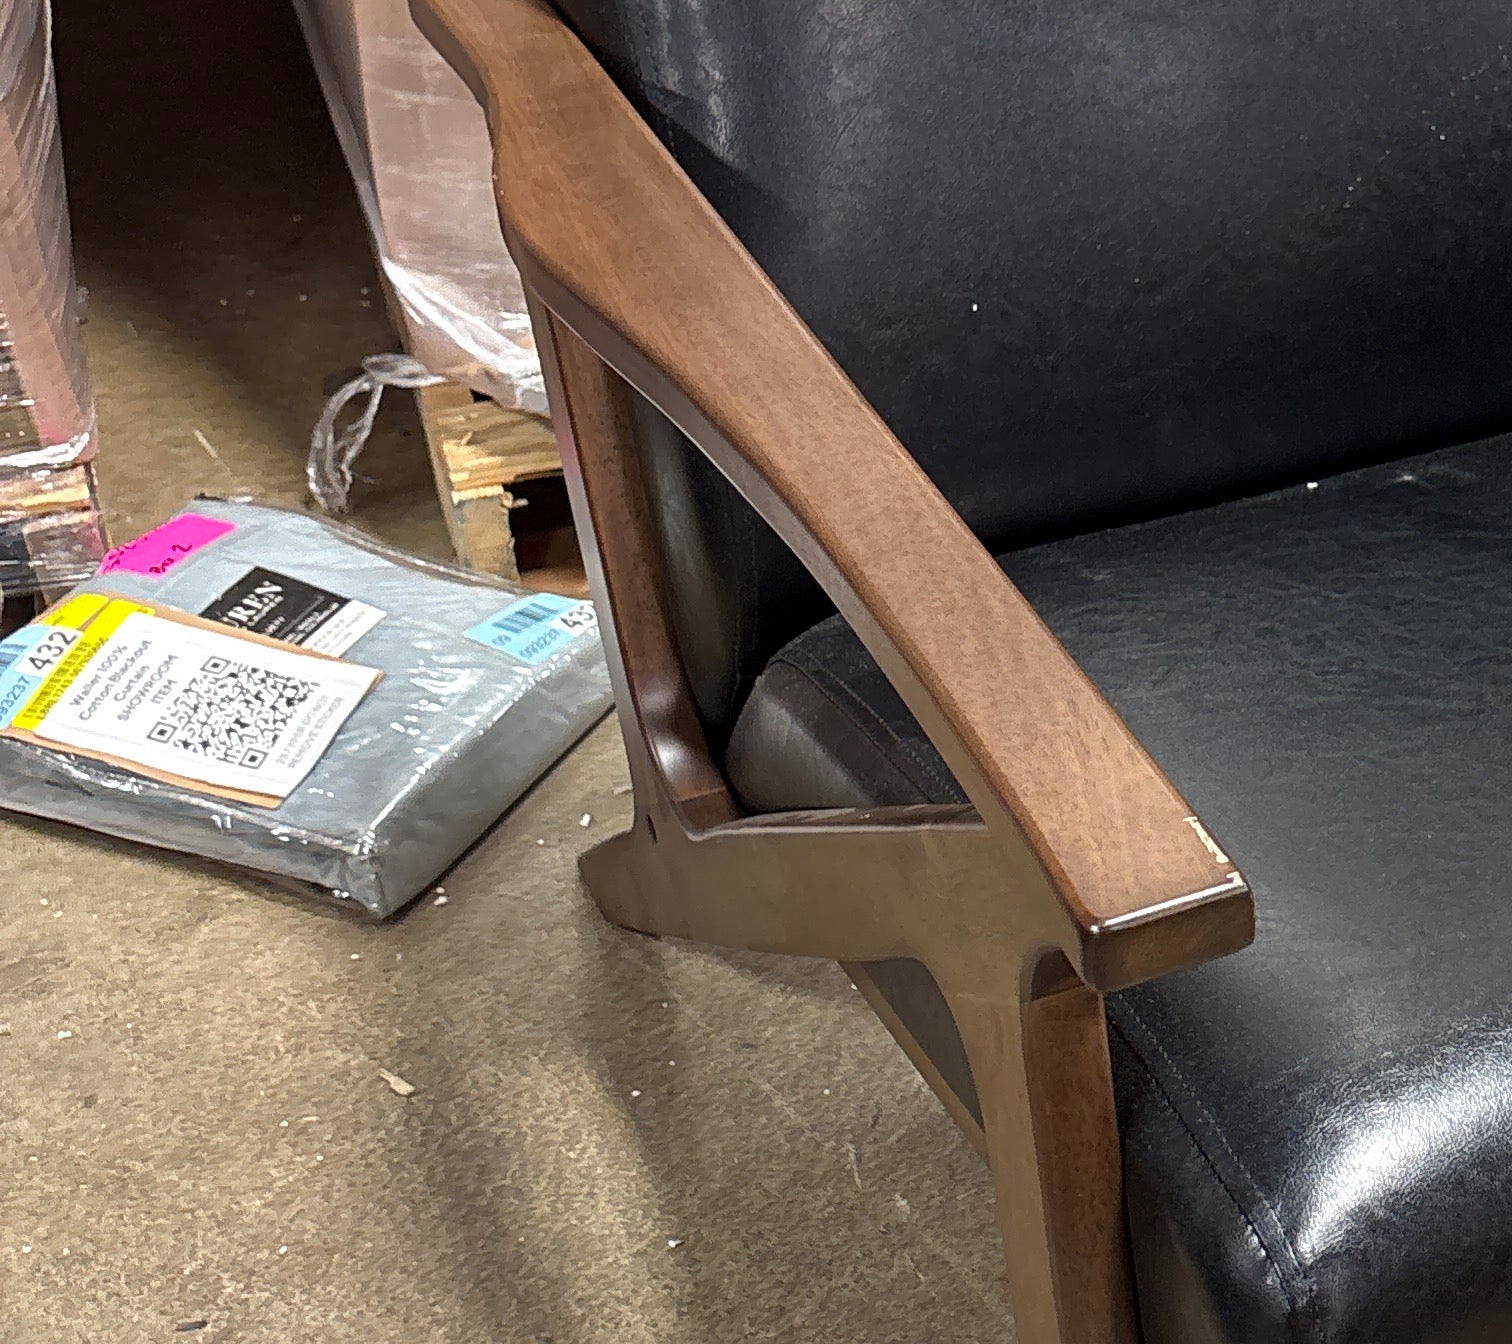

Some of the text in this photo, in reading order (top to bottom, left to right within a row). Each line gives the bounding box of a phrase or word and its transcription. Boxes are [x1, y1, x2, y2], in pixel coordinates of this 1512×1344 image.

[560, 605, 594, 628] 43
[28, 631, 78, 670] 432
[97, 645, 128, 672] 100%
[79, 640, 152, 720] Cotton Blackout
[114, 665, 150, 702] Curtain
[117, 654, 179, 721] SHOWROOM
[150, 679, 178, 705] ITEM
